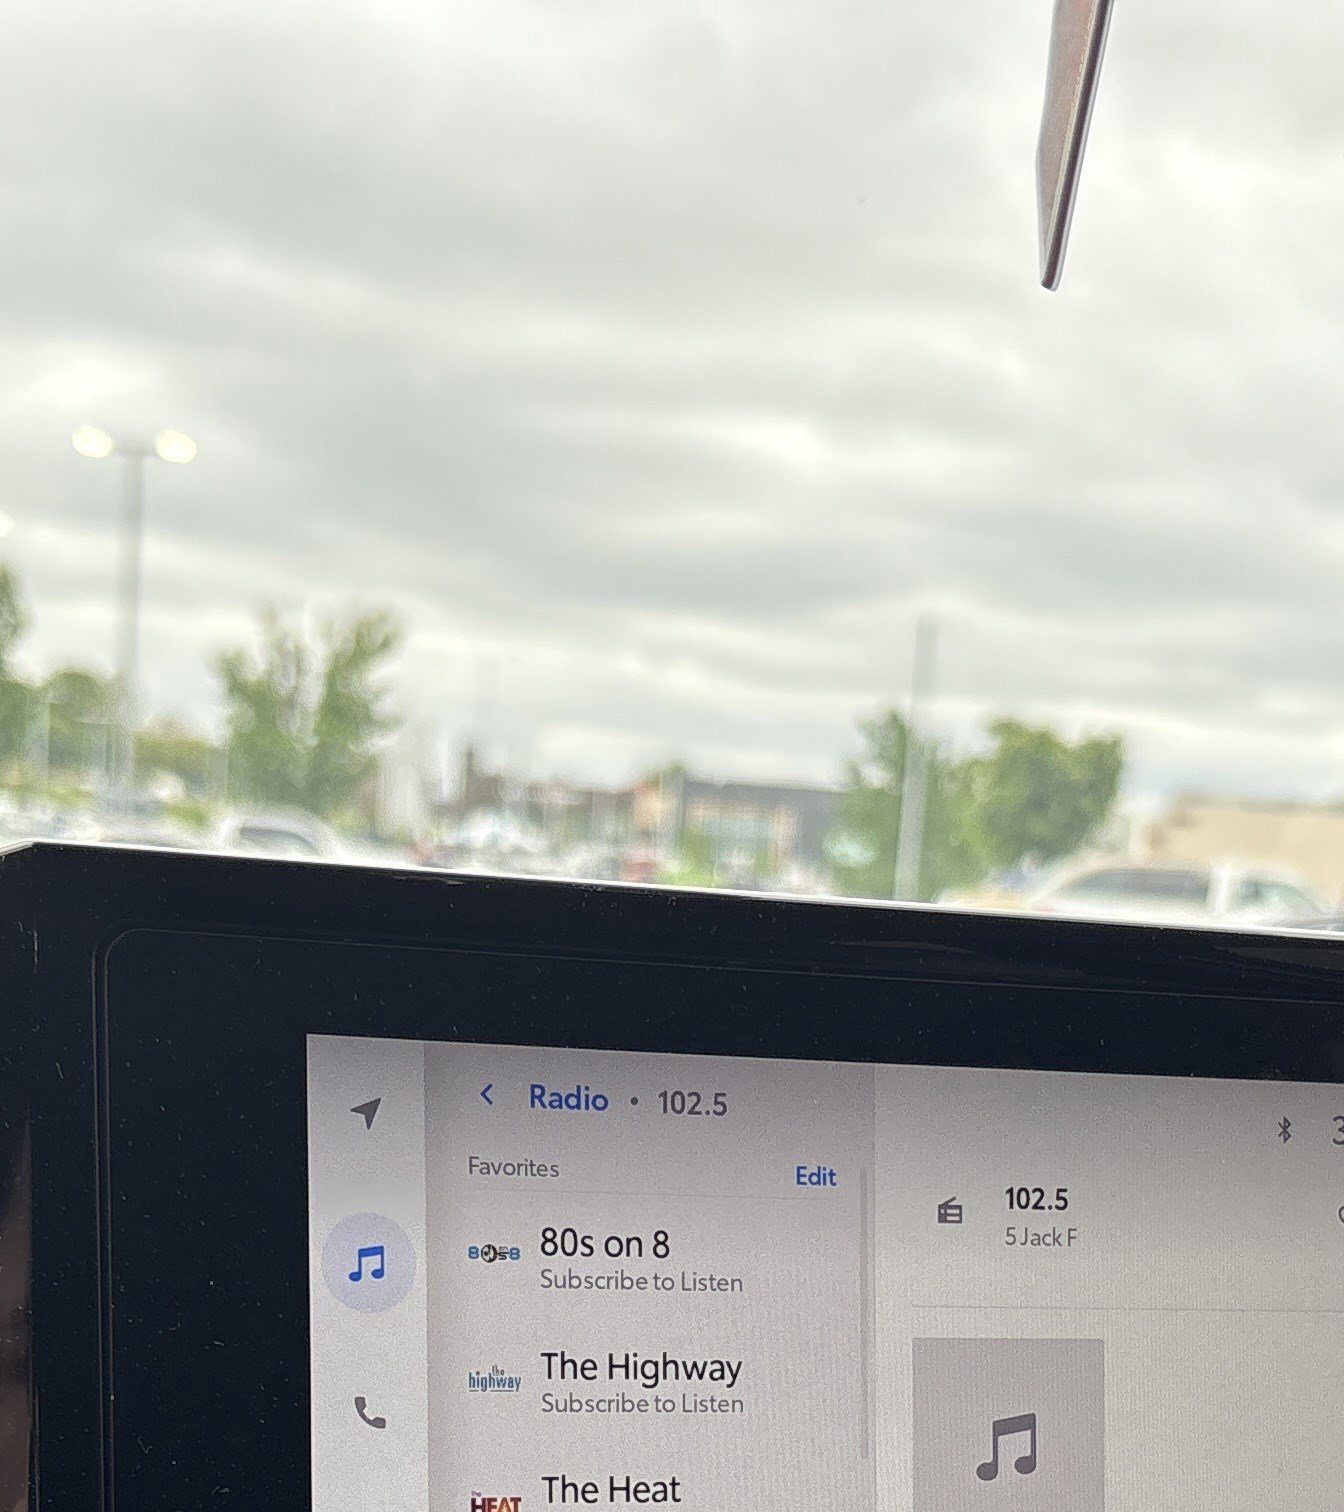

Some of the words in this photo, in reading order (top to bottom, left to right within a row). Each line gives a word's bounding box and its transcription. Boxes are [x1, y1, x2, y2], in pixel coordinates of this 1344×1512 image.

[530, 1083, 609, 1111] Radio
[658, 1090, 728, 1117] 102.5
[468, 1155, 560, 1178] Favorites
[796, 1165, 837, 1187] Edit
[1005, 1186, 1069, 1211] 102.5
[540, 1226, 595, 1258] 80s
[604, 1235, 643, 1258] on
[652, 1229, 670, 1259] 8
[1005, 1226, 1017, 1246] 5
[1020, 1226, 1063, 1247] Jack
[1067, 1227, 1078, 1247] F
[540, 1267, 649, 1291] Subscribe
[652, 1272, 675, 1292] to
[681, 1271, 743, 1292] Listen
[468, 1371, 521, 1392] highway
[540, 1350, 598, 1381] The
[608, 1351, 743, 1389] Highway
[541, 1391, 650, 1413] Subscribe
[653, 1395, 676, 1413] to
[682, 1393, 744, 1414] Listen
[541, 1474, 599, 1504] The
[609, 1475, 682, 1504] Heat
